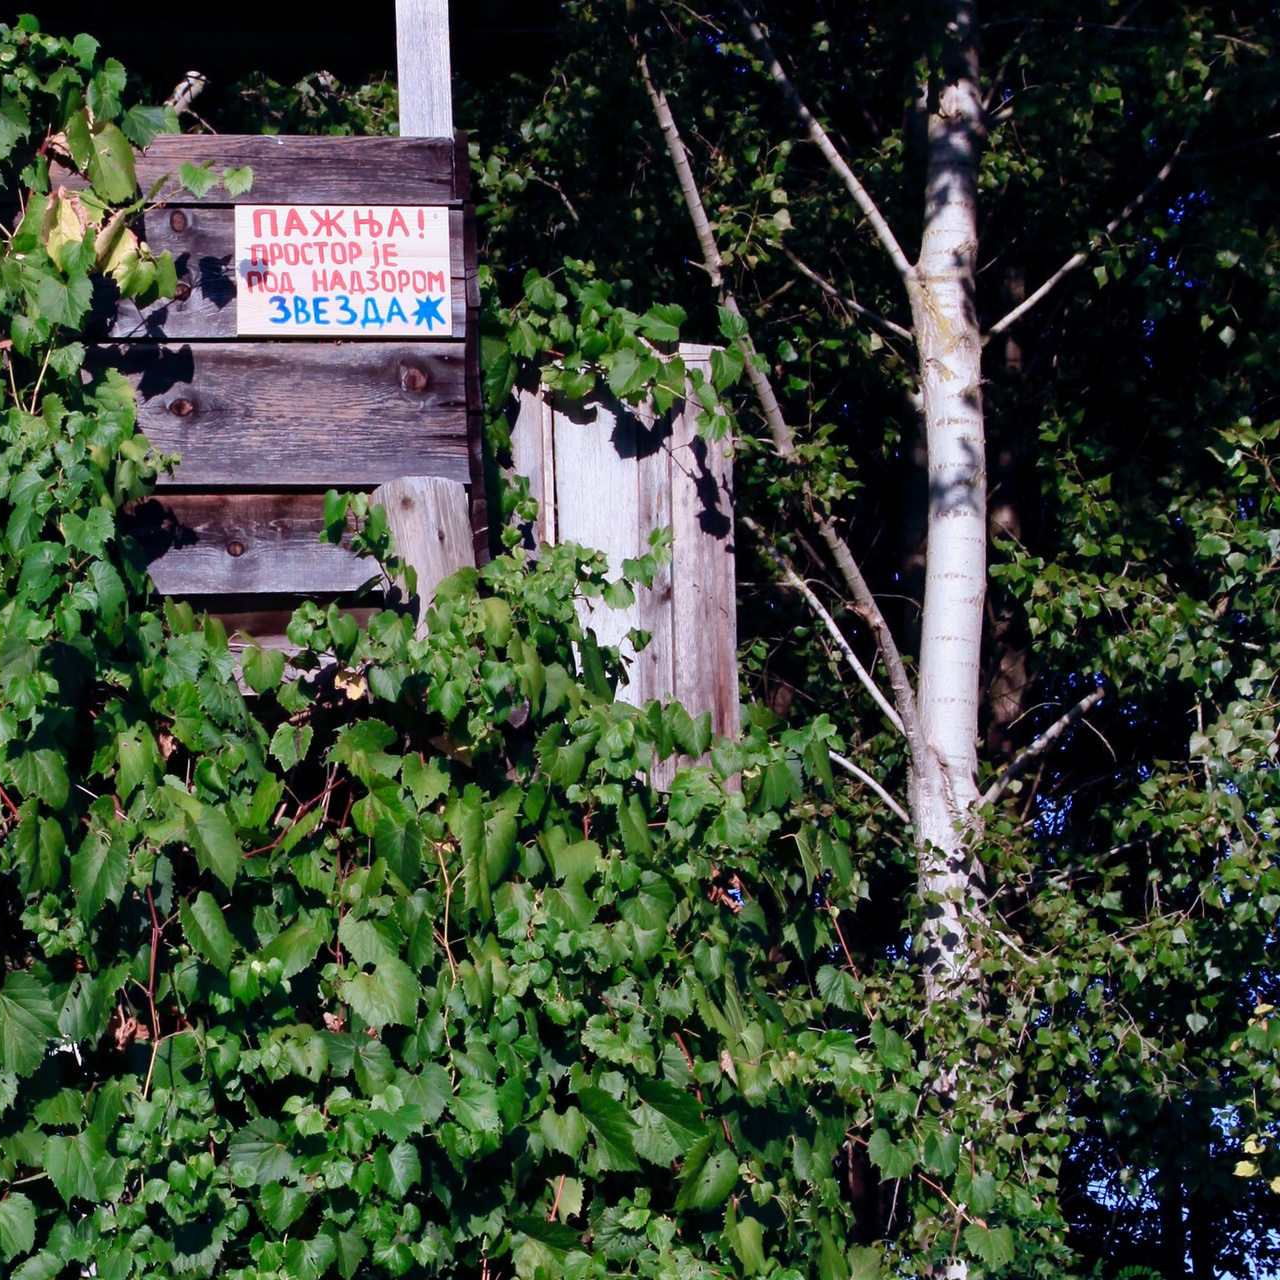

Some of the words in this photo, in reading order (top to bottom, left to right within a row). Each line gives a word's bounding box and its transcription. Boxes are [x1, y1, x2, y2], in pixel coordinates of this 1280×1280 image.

[252, 208, 425, 239] ПАЖЊА!
[250, 241, 362, 266] ПРОСТОР
[246, 270, 295, 294] ПОД
[312, 268, 446, 294] НАДЗОРОМ
[268, 294, 409, 330] ЗВЕЗДА
